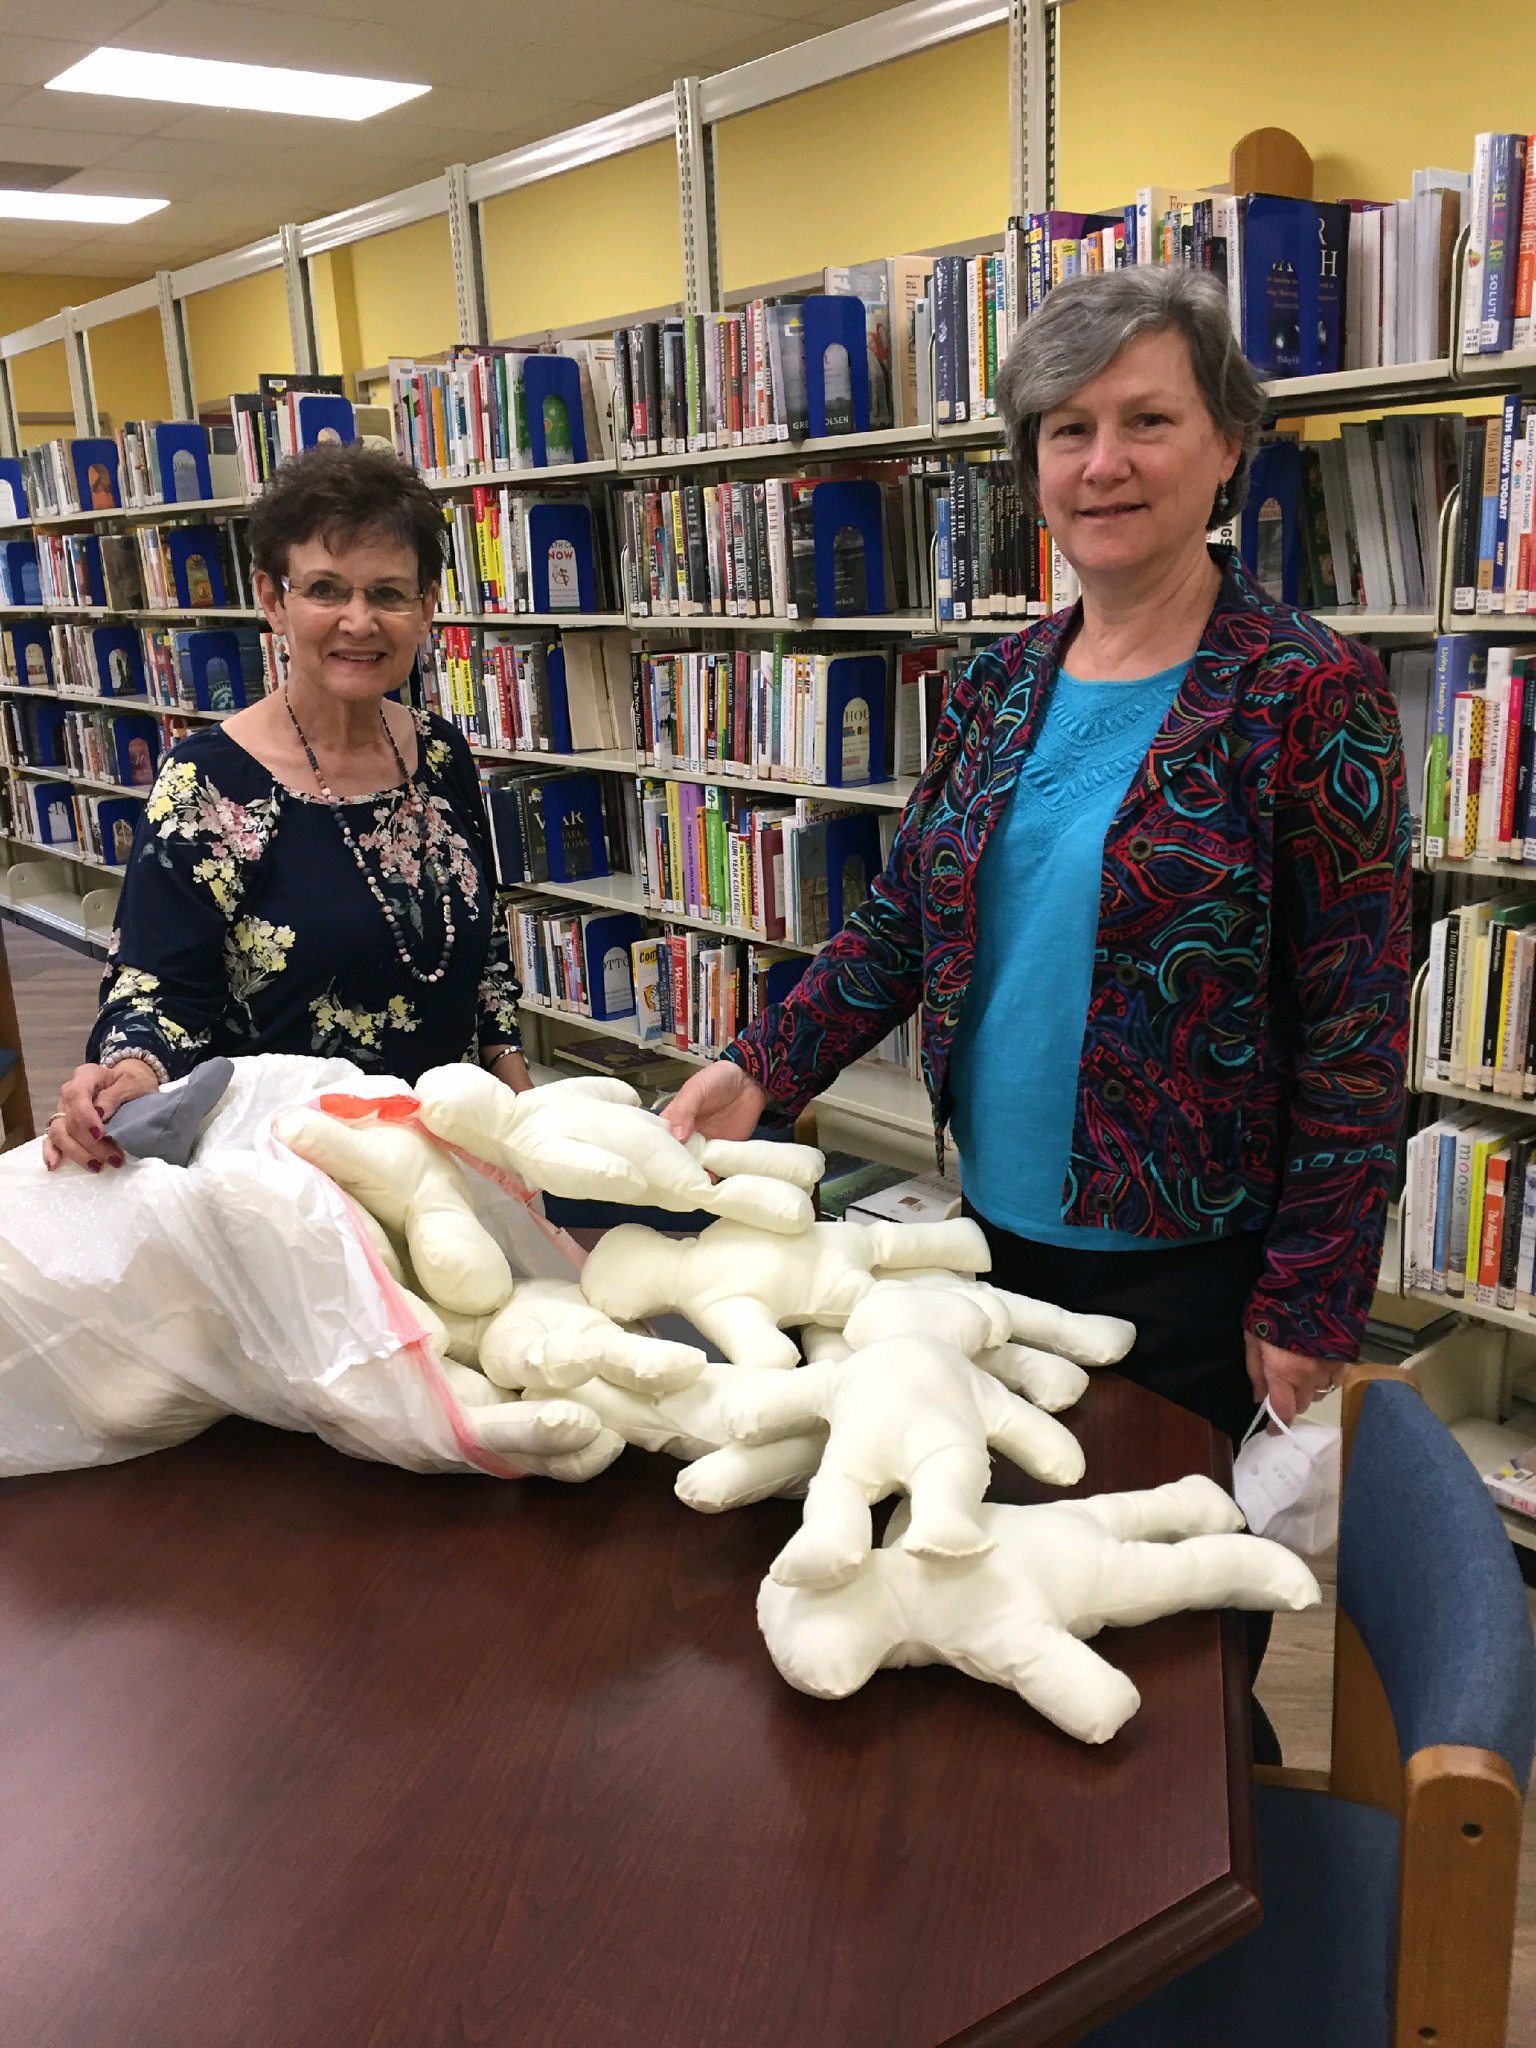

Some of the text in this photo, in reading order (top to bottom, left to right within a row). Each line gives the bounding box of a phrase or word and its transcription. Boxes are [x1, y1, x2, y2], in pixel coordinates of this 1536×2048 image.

[1488, 274, 1498, 321] SOLUTI
[1504, 405, 1514, 432] BETH
[1526, 449, 1534, 471] YOGA
[1524, 474, 1532, 491] FOR
[1522, 493, 1531, 530] SENIORS
[1438, 647, 1449, 672] Living
[1437, 682, 1447, 714] Healthy
[1437, 716, 1447, 732] Life
[675, 966, 684, 1018] Webster's
[1456, 1144, 1472, 1206] moose
[1484, 1209, 1499, 1267] The Allergy Book
